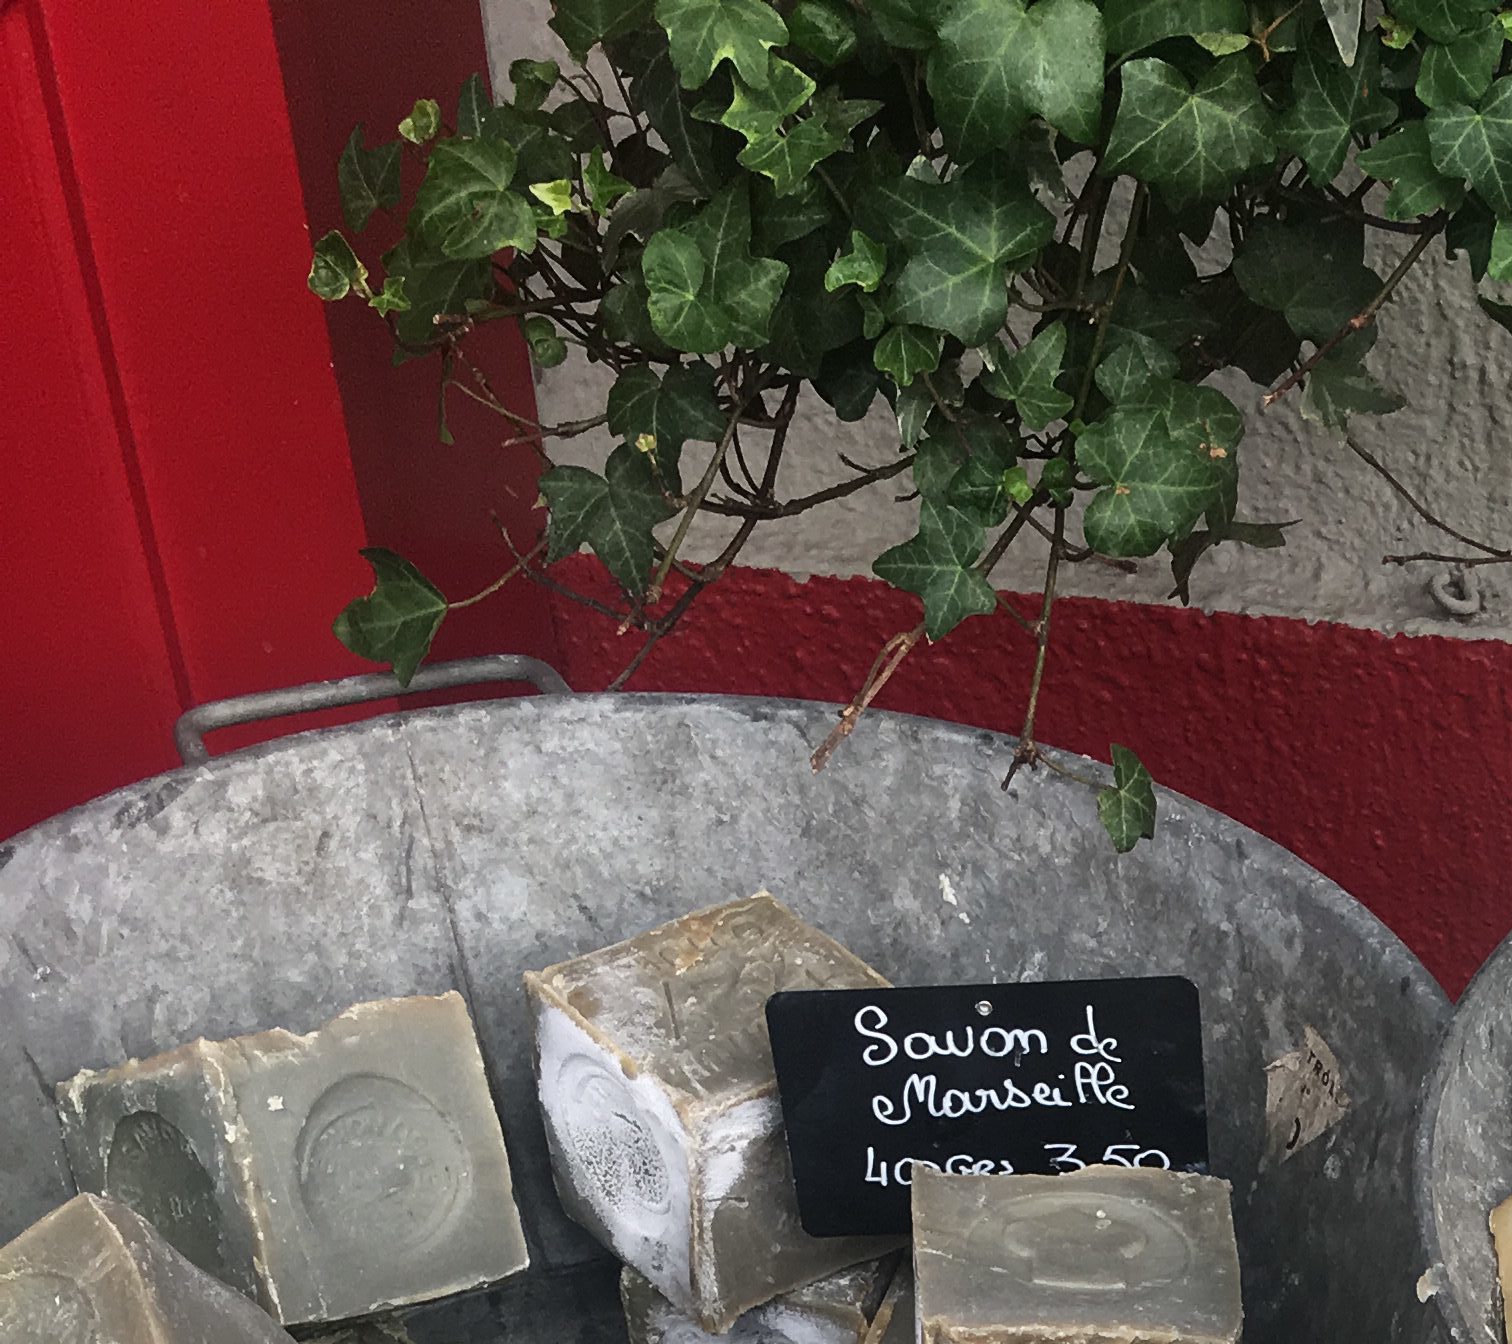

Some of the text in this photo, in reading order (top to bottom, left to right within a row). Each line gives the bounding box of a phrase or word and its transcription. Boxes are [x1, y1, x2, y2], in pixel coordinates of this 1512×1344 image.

[854, 1005, 1122, 1066] Savon de
[872, 1062, 1135, 1125] Marseille
